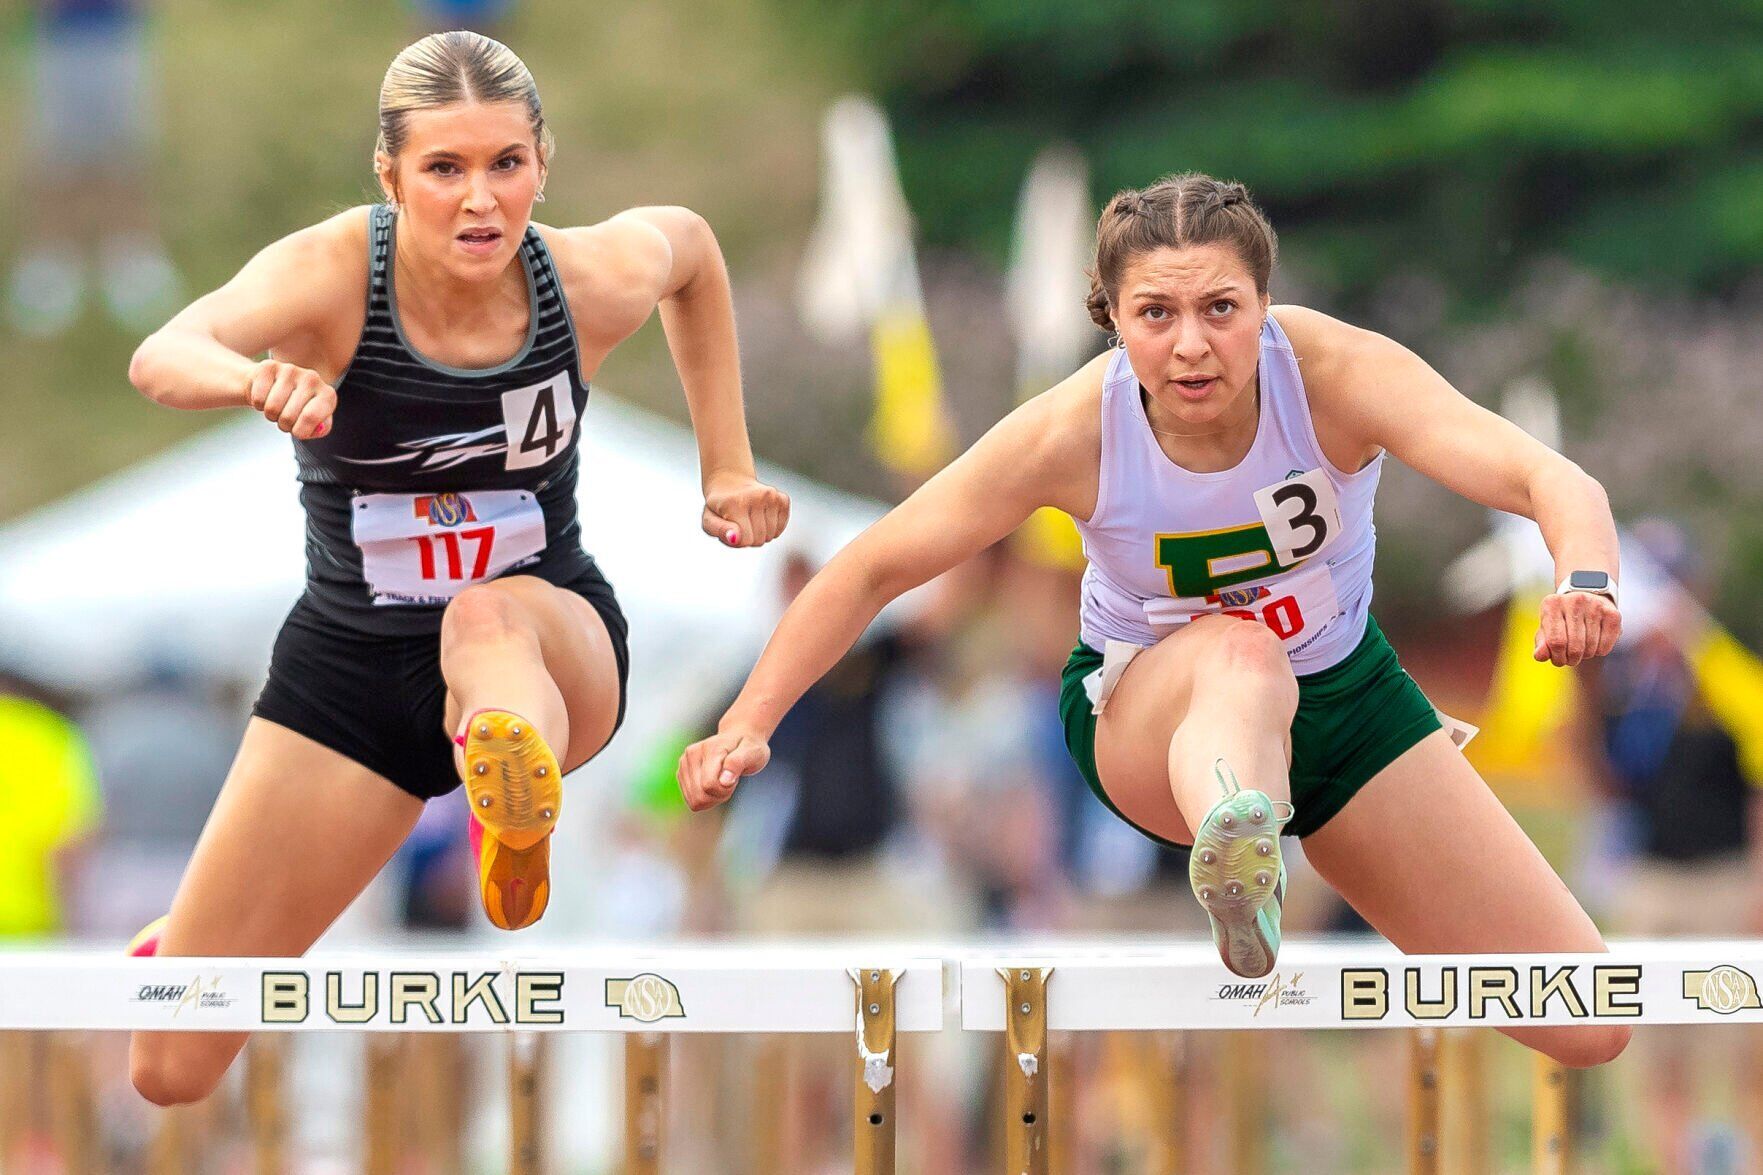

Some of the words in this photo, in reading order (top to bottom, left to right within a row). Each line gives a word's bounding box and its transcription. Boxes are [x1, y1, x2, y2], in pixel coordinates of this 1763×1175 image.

[520, 385, 564, 457] 4
[1272, 483, 1328, 559] 3
[409, 526, 495, 580] 117
[1287, 624, 1328, 657] PIONSHIPS
[261, 970, 564, 1024] BURKE
[1279, 998, 1311, 1006] SCHOOLS
[1341, 965, 1643, 1020] BURKE
